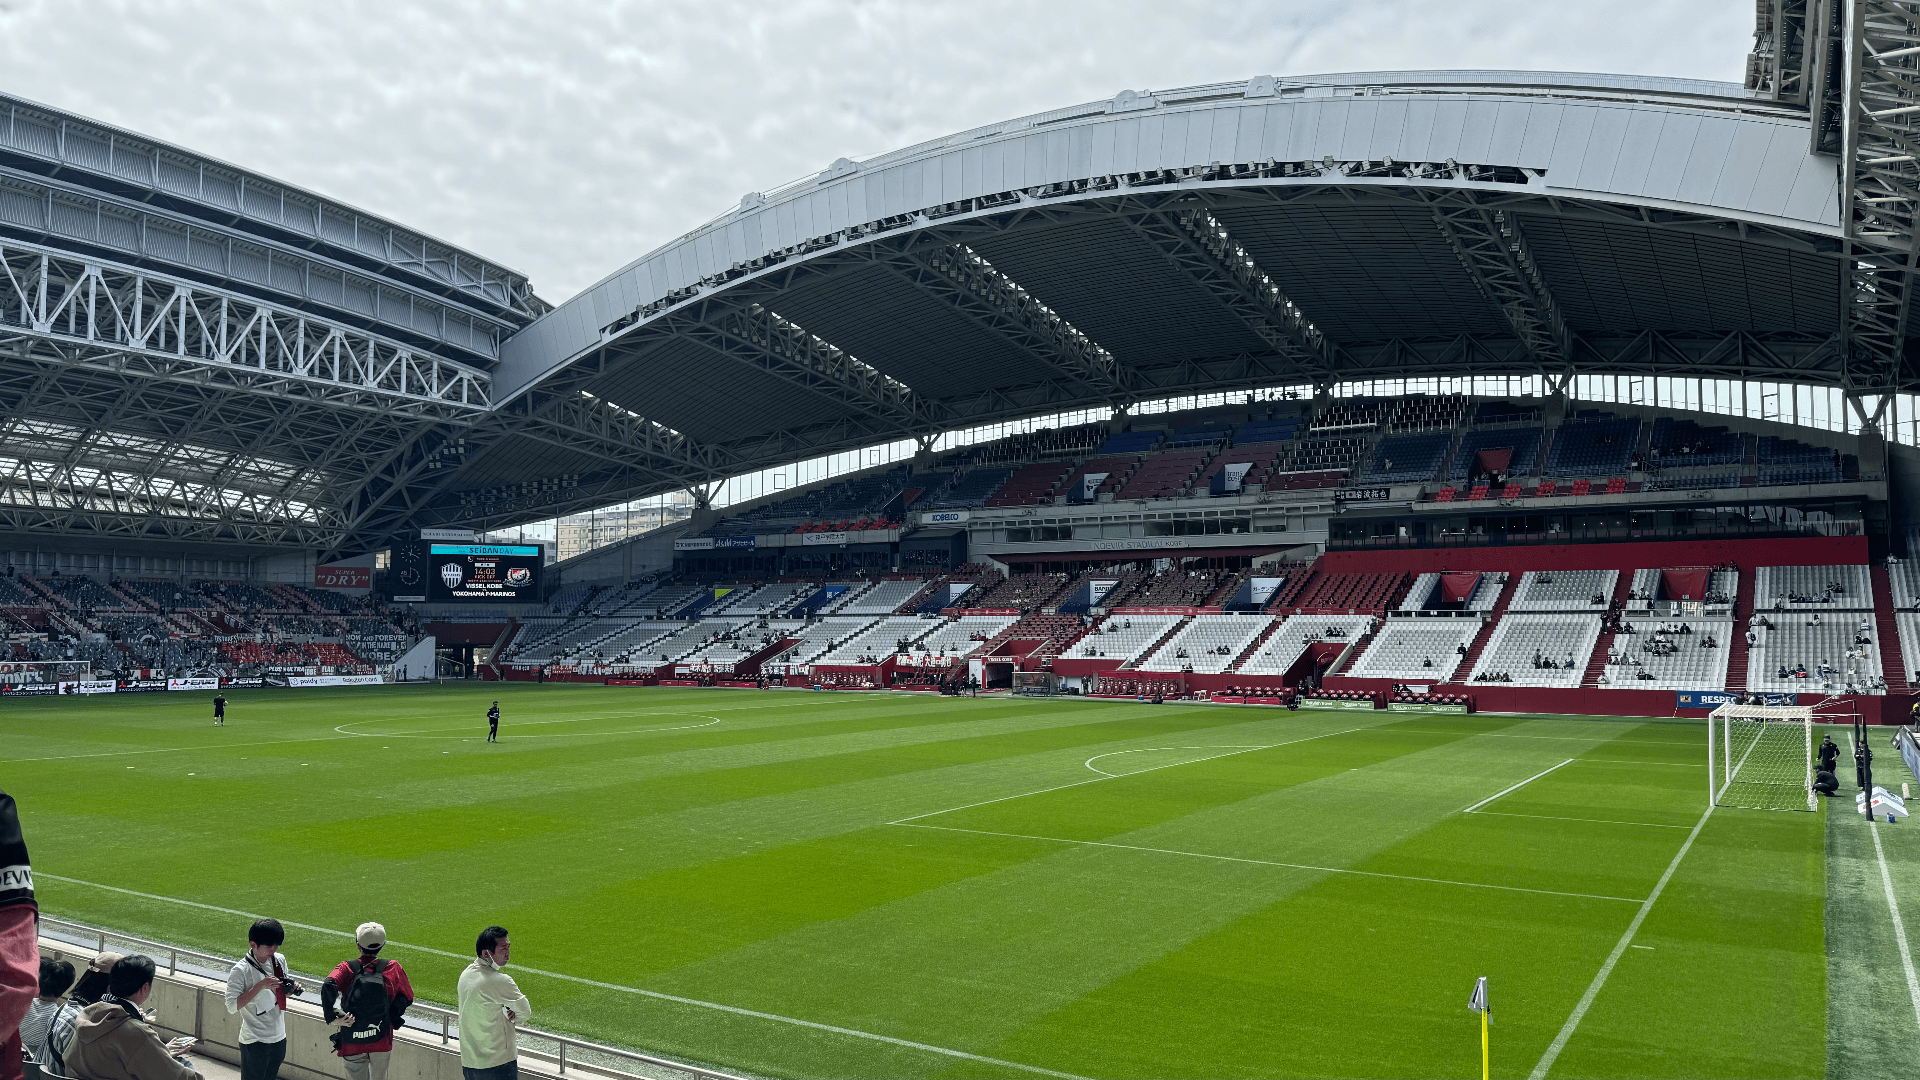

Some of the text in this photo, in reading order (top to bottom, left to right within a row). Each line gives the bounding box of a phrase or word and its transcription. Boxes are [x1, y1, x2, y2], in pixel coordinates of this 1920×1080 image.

[1126, 541, 1163, 549] STADIUM
[362, 652, 391, 660] KOBE
[1701, 695, 1738, 703] RESPEC
[353, 1029, 377, 1039] PUMA
